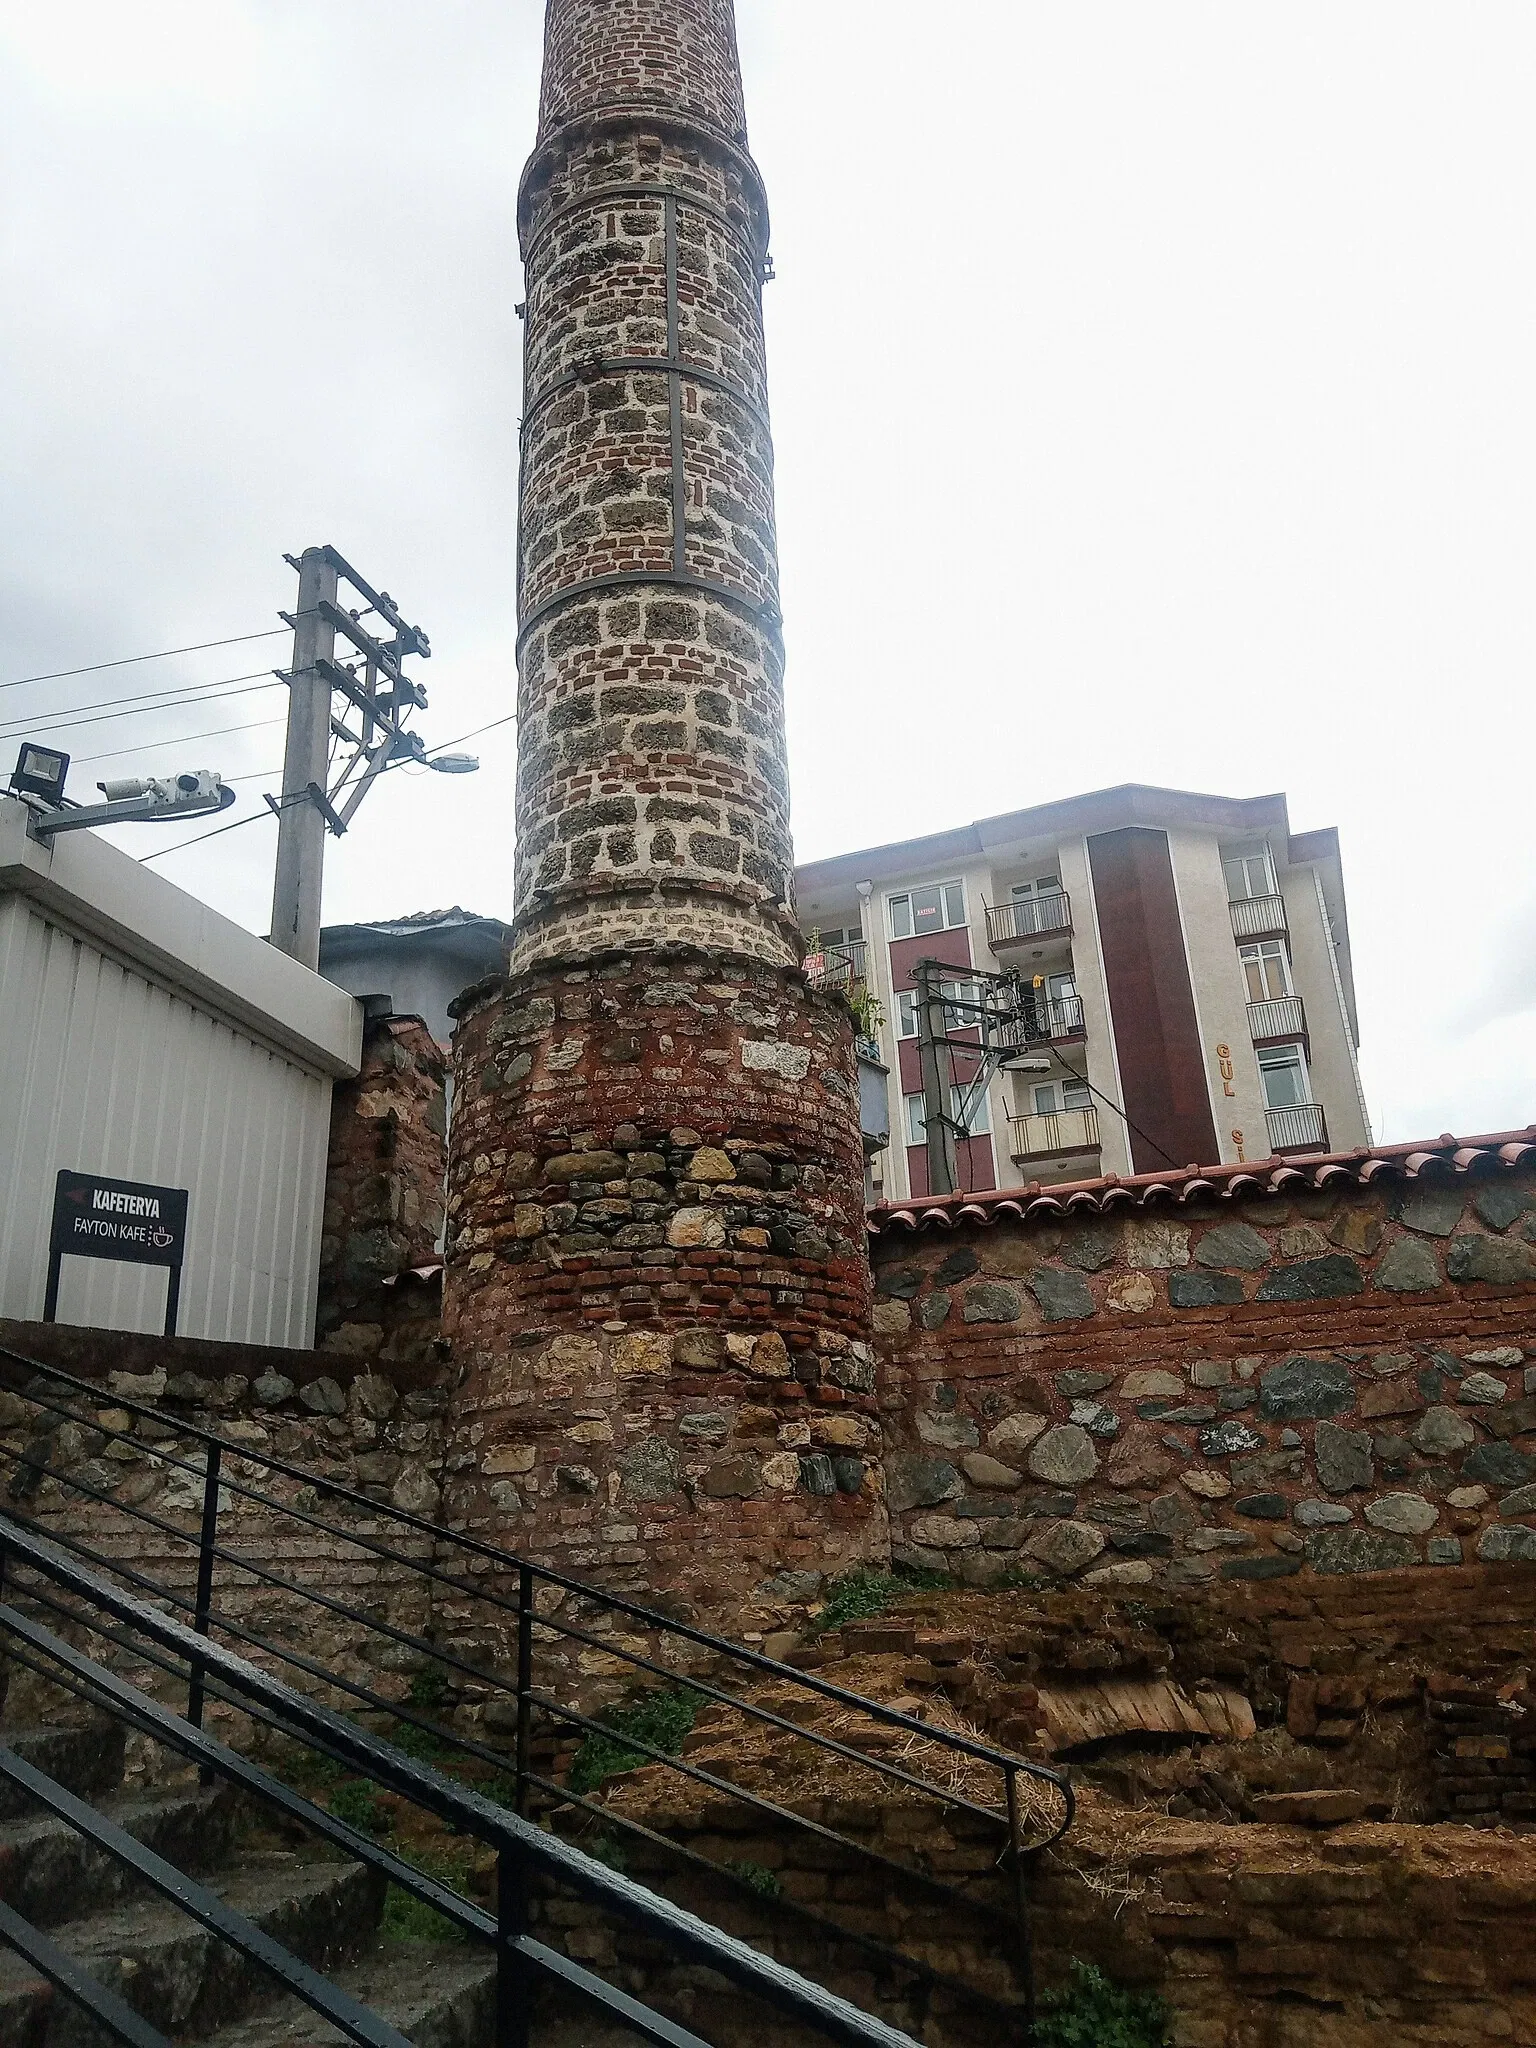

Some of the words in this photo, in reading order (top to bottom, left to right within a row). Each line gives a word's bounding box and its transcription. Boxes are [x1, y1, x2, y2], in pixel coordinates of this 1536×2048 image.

[1217, 1044, 1235, 1097] GÜL
[92, 1189, 160, 1218] KAFETERYA
[74, 1217, 117, 1238] FAYTON
[119, 1224, 147, 1242] KAFE
